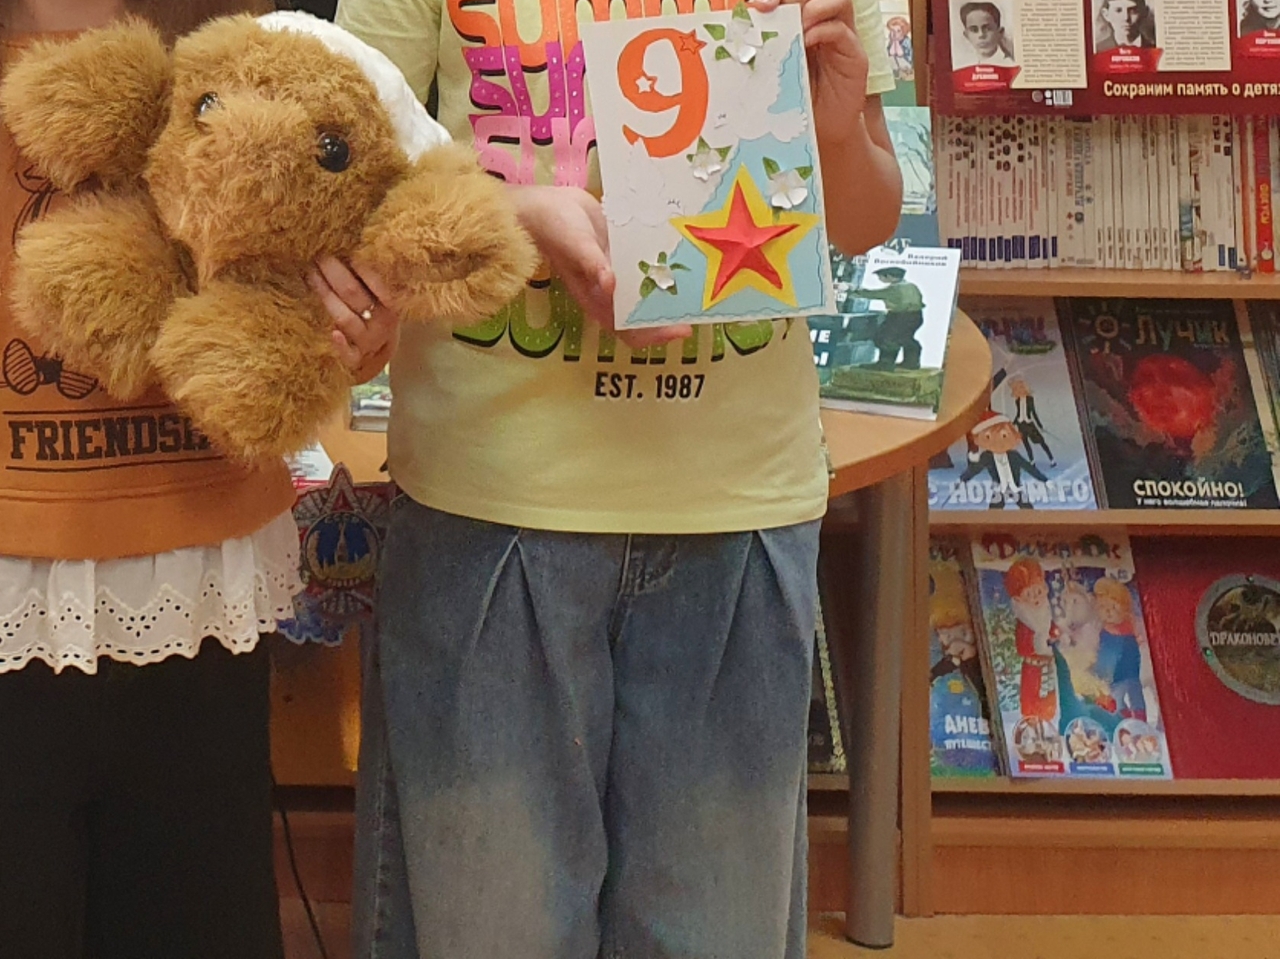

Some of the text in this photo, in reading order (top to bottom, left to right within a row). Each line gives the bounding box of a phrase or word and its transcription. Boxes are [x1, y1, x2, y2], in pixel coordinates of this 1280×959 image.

[617, 28, 709, 158] 9
[1103, 80, 1172, 97] Сохраним
[1176, 80, 1229, 96] память
[1232, 83, 1240, 95] о
[594, 371, 705, 400] EST. 1987
[948, 480, 1049, 505] НОВЫМ
[1133, 477, 1245, 500] СПОКОЙНО!
